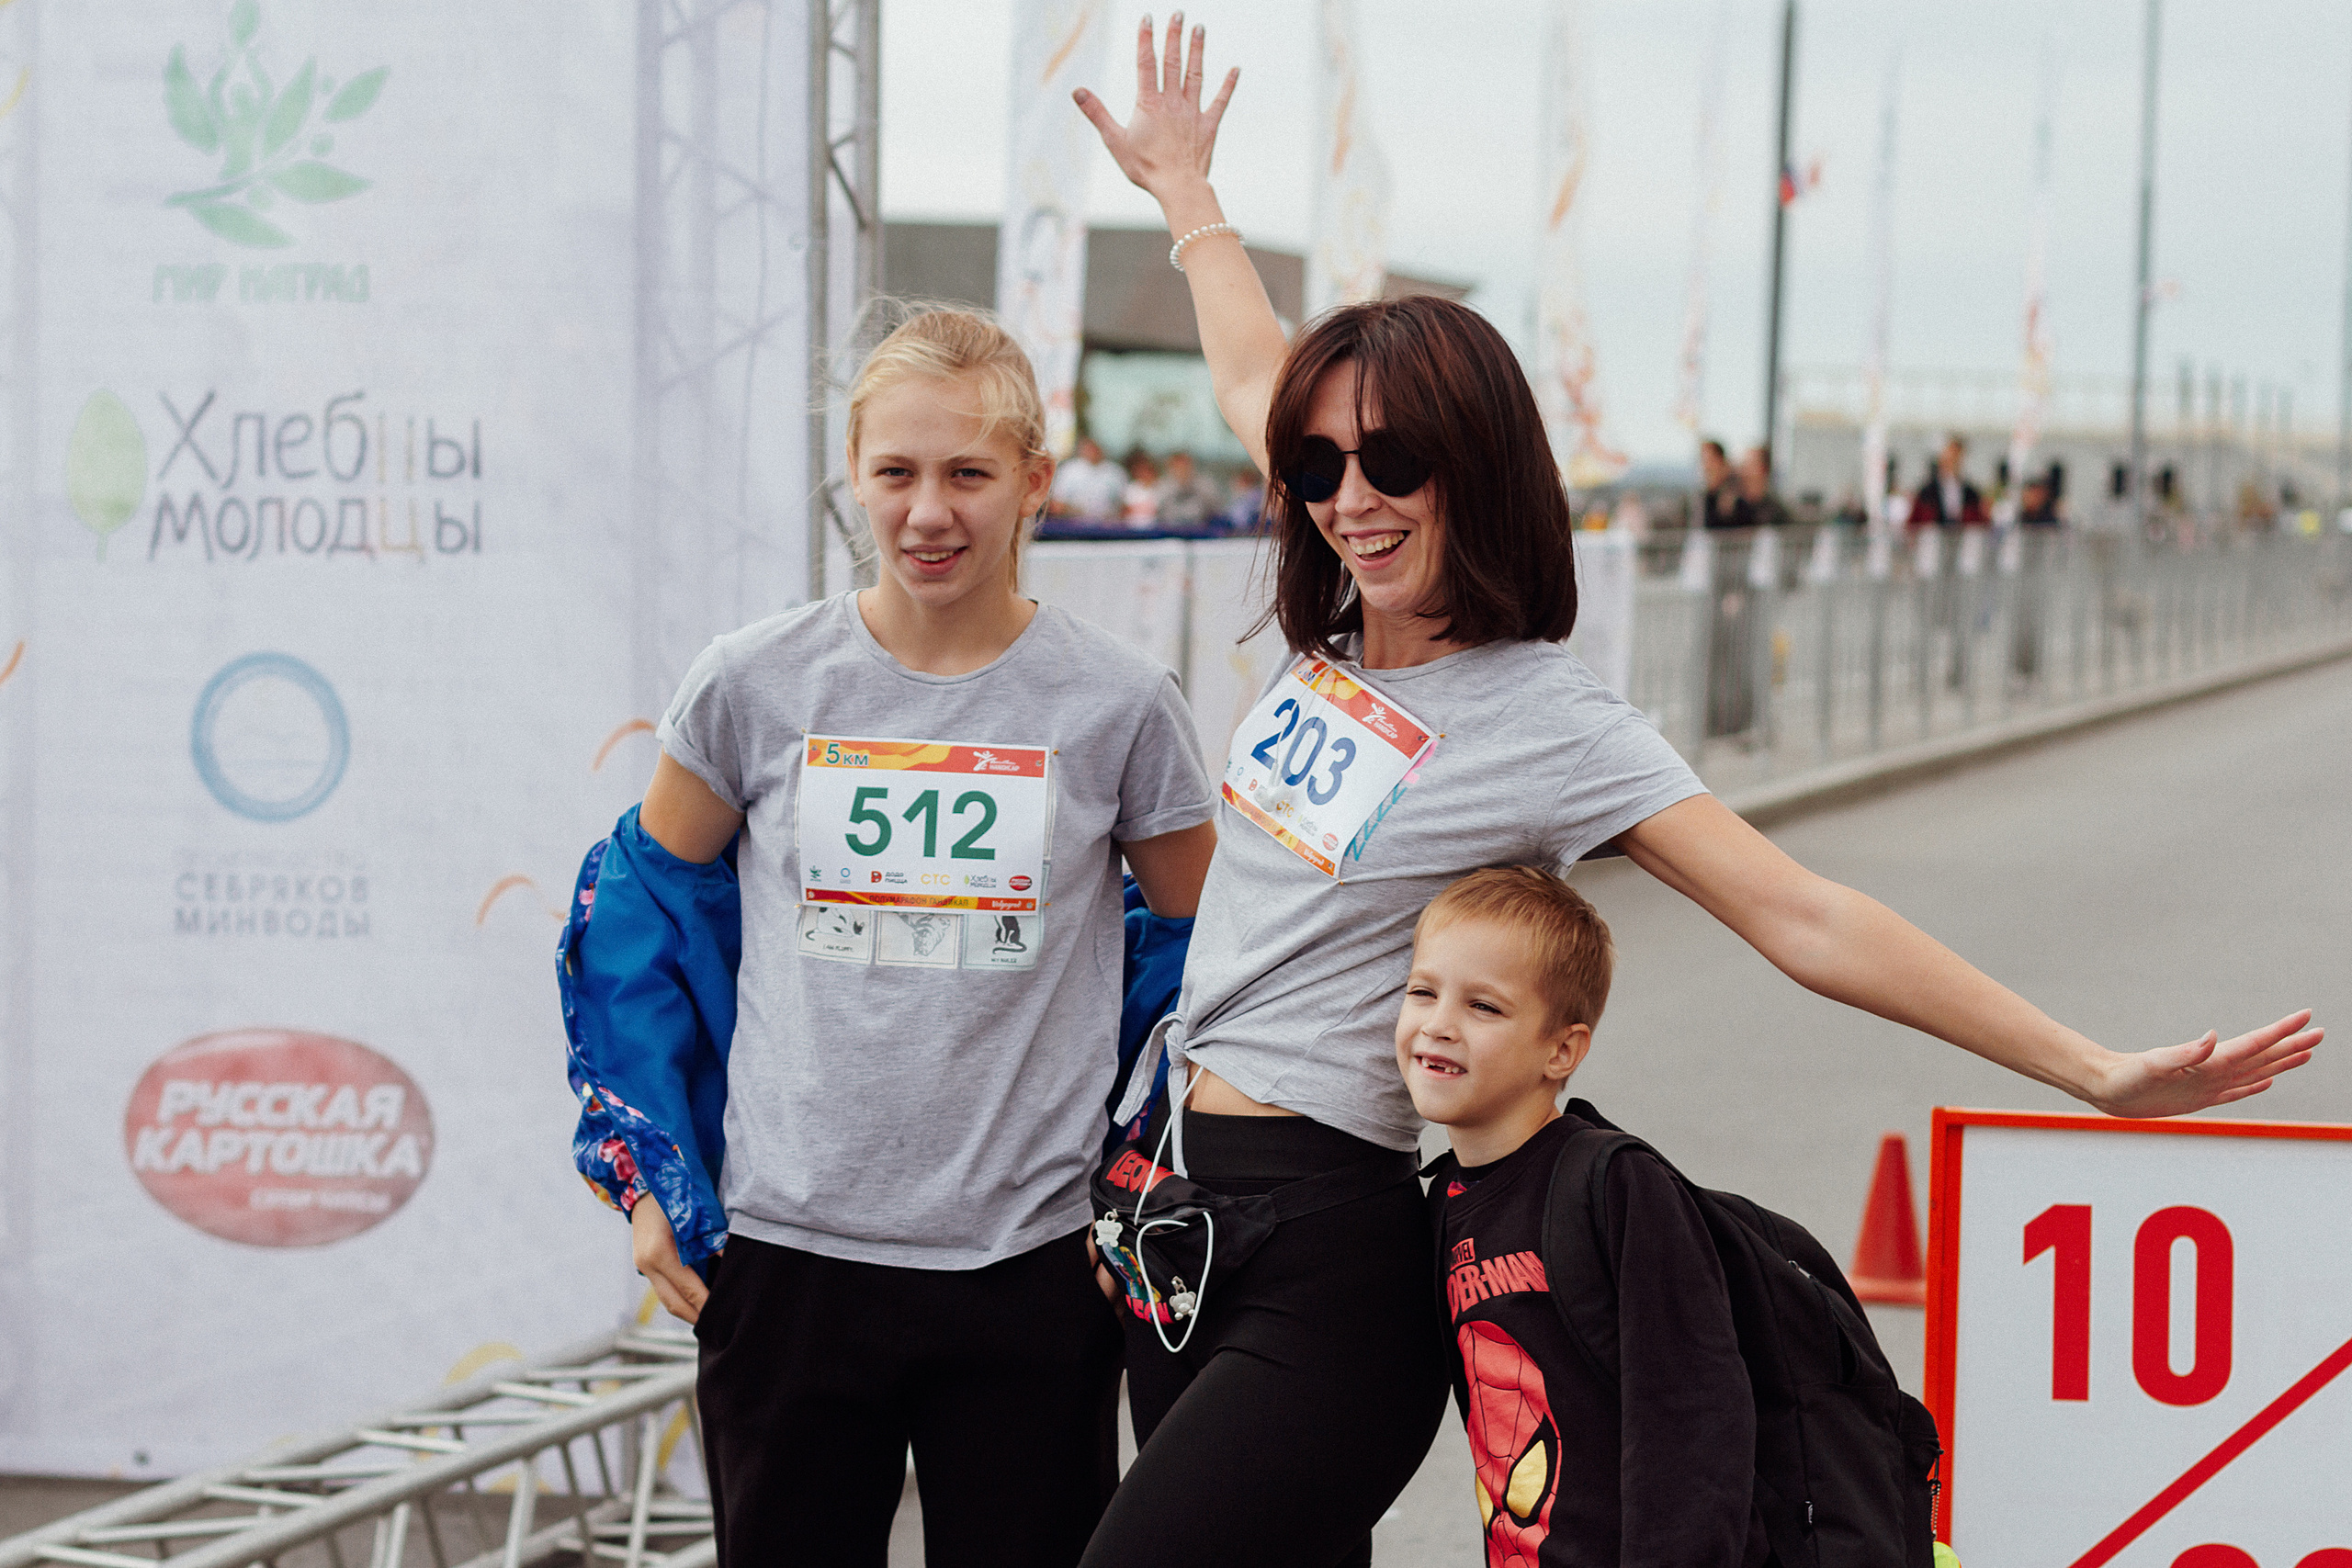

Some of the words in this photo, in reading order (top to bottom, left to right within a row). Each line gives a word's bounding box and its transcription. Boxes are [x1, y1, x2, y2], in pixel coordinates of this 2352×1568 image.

[1250, 698, 1357, 806] 203
[845, 786, 998, 861] 512
[175, 872, 368, 904] СЕБРЯКОВ
[174, 907, 371, 939] МИНВОДЫ
[158, 1079, 406, 1129] РУССКАЯ
[133, 1126, 423, 1178] КАРТОШКА
[1447, 1251, 1550, 1323] DER-MAN
[2022, 1204, 2234, 1405] 10
